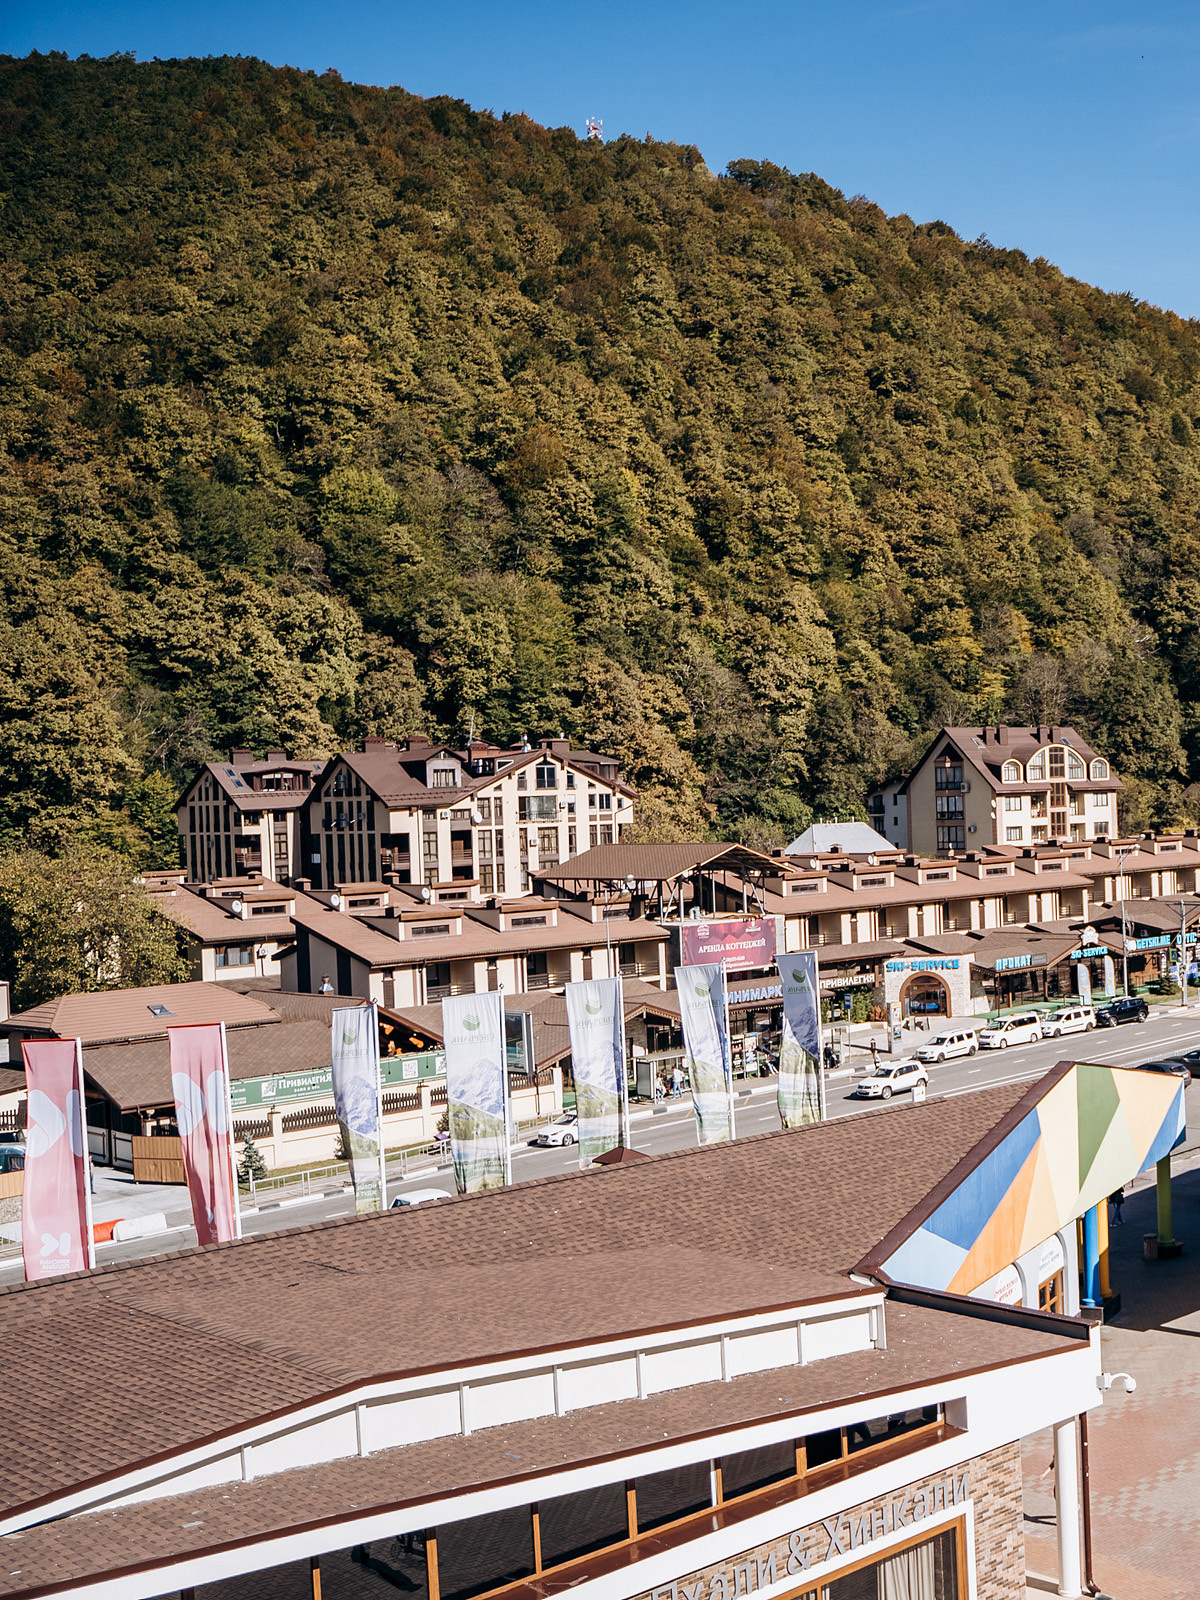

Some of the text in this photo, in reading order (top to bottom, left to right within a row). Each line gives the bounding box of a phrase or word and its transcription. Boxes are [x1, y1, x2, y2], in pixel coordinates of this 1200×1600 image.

[698, 937, 766, 954] АРЕНДА КОТТЕДЖЕЙ
[1176, 932, 1198, 945] OTIC
[995, 954, 1032, 971] ПРОКАТ
[819, 973, 875, 990] ПРИВИЛЕГИЯ
[786, 1531, 811, 1575] &
[822, 1473, 969, 1562] Хинкали
